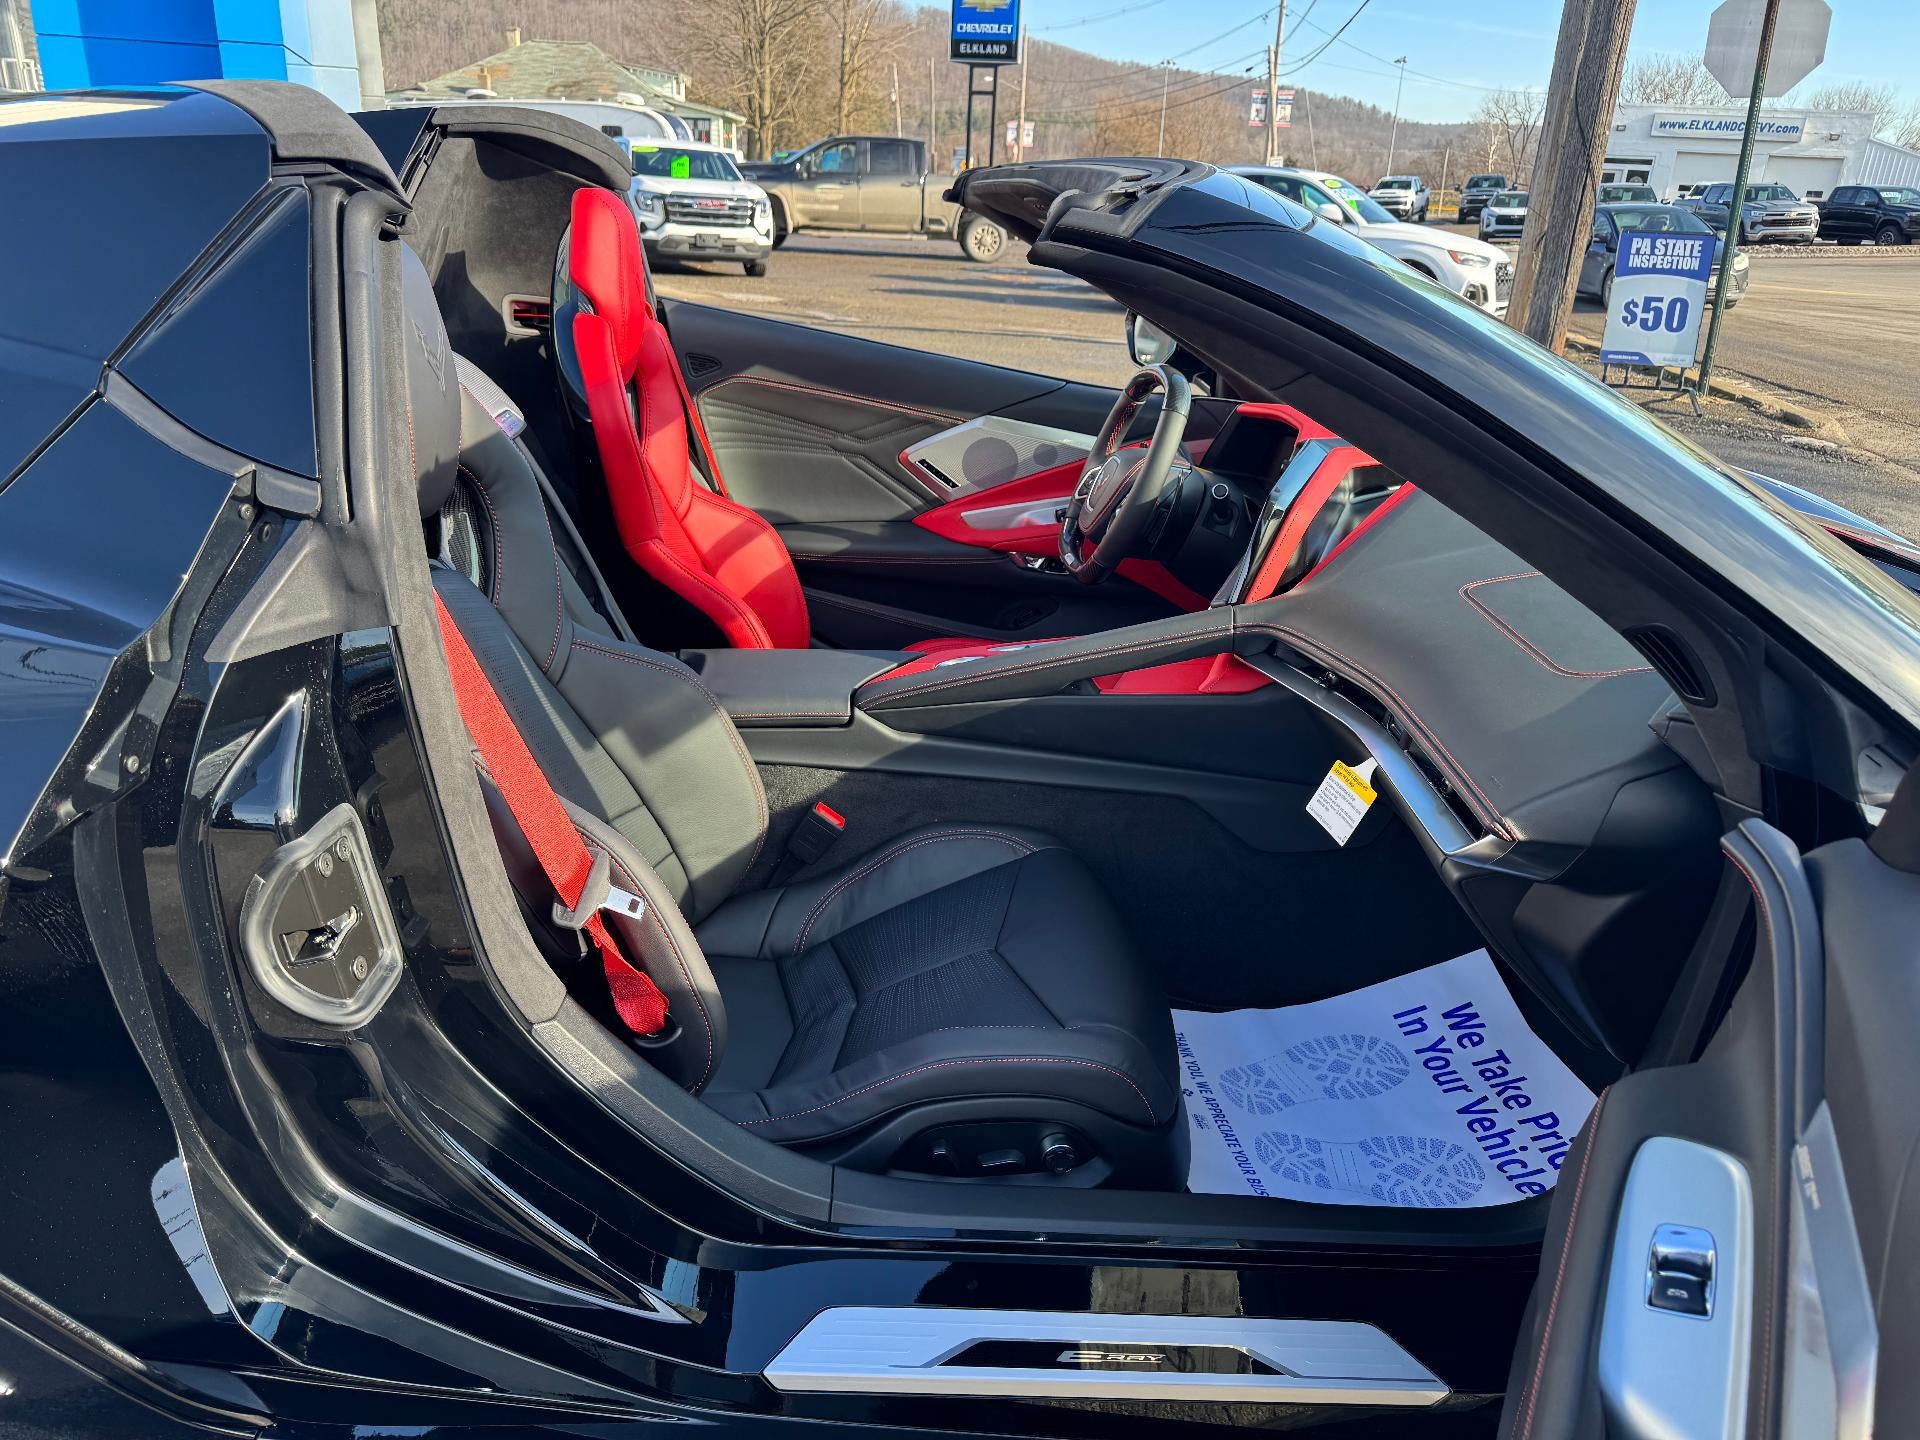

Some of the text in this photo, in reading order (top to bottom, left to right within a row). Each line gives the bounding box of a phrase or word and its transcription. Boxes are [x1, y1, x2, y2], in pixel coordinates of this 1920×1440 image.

[956, 23, 1014, 34] CHEVROLET
[959, 42, 1008, 55] ELKLAND
[1658, 119, 1800, 134] www.ELKLANDCVY.com
[1630, 237, 1703, 257] PA STATE
[1628, 254, 1700, 271] INSPECTION
[1621, 295, 1690, 333] $50
[1176, 1032, 1195, 1058] THANK
[1441, 1001, 1487, 1050] We
[1471, 1049, 1532, 1110] Take
[1184, 1060, 1204, 1080] YOU,
[1195, 1081, 1213, 1095] WE
[1392, 1004, 1548, 1199] In Your Vehicle
[1202, 1095, 1242, 1148] APPRECIATE
[1231, 1149, 1256, 1175] YOUR
